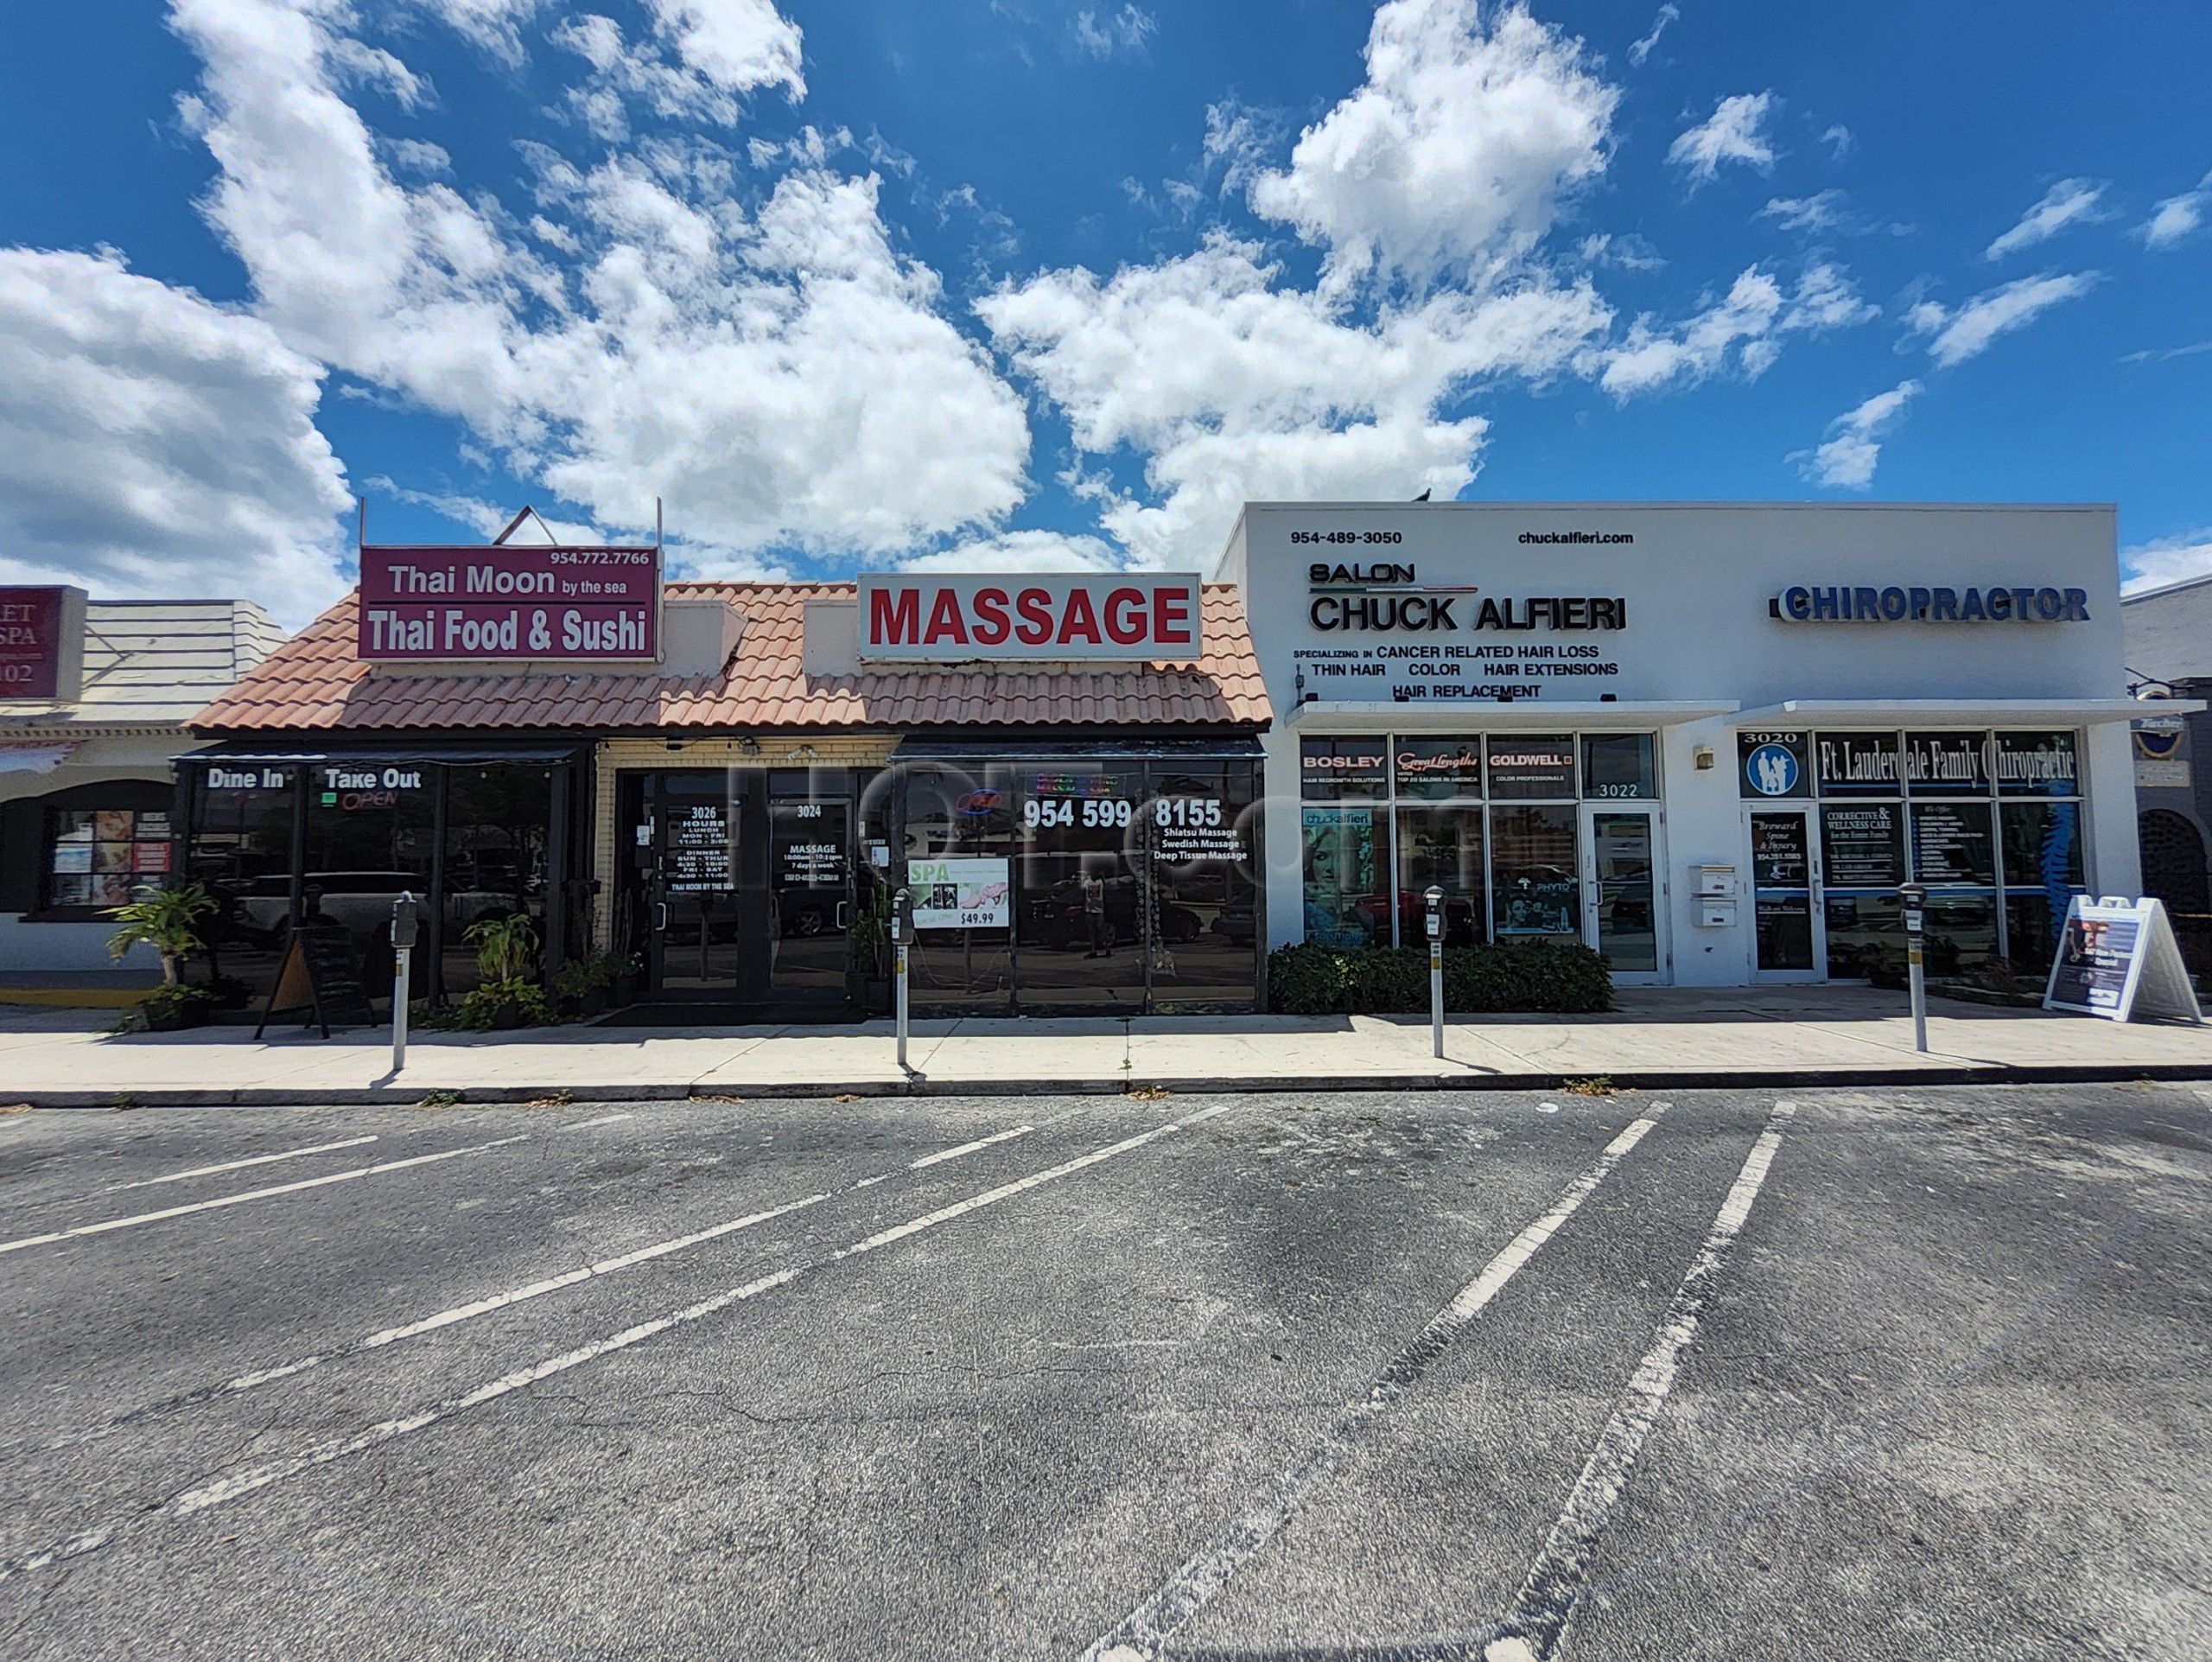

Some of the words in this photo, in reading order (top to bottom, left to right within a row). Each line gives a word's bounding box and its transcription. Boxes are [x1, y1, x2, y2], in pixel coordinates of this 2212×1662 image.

[1290, 531, 1403, 545] 954-489-3050
[1518, 532, 1634, 545] chuckalfieri.com
[550, 551, 650, 565] 954.772.7766
[1309, 564, 1415, 583] SALON
[388, 565, 456, 594] Thai
[466, 565, 556, 595] Moon
[563, 580, 577, 596] by
[580, 580, 601, 594] the
[604, 583, 627, 595] sea
[1785, 586, 2092, 622] CHIROPRACTOR
[0, 604, 37, 622] ET
[870, 587, 1192, 646] MASSAGE
[1310, 596, 1459, 632] CHUCK
[1474, 597, 1627, 631] ALFIERI
[367, 609, 435, 650] Thai
[444, 610, 518, 650] Food
[528, 609, 552, 650] &
[562, 609, 646, 650] Sushi
[1294, 650, 1359, 659] SPECIALIZING
[1363, 650, 1373, 659] IN
[1376, 646, 1440, 659] CANCER
[1445, 646, 1514, 659] RELATED
[1517, 646, 1554, 659] HAIR
[1558, 646, 1599, 658] LOSS
[1312, 664, 1346, 677] THIN
[1351, 664, 1387, 677] HAIR
[1408, 664, 1461, 677] COLOR
[1484, 664, 1520, 676] HAIR
[1524, 663, 1619, 676] EXTENSIONS
[1392, 685, 1427, 698] HAIR
[1433, 685, 1541, 697] REPLACEMENT
[1744, 733, 1797, 743] 3020
[1303, 756, 1384, 767] BOSLEY
[1490, 755, 1562, 766] GOLDWELL
[1821, 742, 1842, 780] Ft.
[1931, 741, 1980, 789] Family
[1981, 740, 2074, 788] Chiropractic
[207, 768, 257, 788] Dine
[263, 768, 283, 788] In
[324, 768, 377, 788] Take
[383, 768, 422, 788] Out
[1599, 785, 1637, 797] 3022
[342, 792, 396, 811] OPEN
[691, 806, 717, 819] 3026
[797, 806, 822, 818] 3024
[1024, 800, 1074, 828] 954
[1083, 800, 1132, 828] 599
[1156, 799, 1222, 826] 8155
[1827, 812, 1878, 820] CORRECTIVE
[1878, 806, 1891, 820] &
[1758, 820, 1797, 831] Broward
[1827, 821, 1869, 830] WELLNESS
[1869, 820, 1892, 830] CARE
[1164, 828, 1198, 837] Shiatsu
[1198, 828, 1237, 838] Massage
[1766, 832, 1789, 841] Spine
[790, 845, 836, 854] MASSAGE
[1161, 839, 1199, 848] Swedish
[1200, 839, 1240, 850] Massage
[1154, 851, 1178, 862] Deep
[1179, 851, 1207, 860] Tissue
[1208, 851, 1248, 862] Massage
[912, 864, 949, 882] SPA
[1537, 882, 1570, 891] PHYTO
[961, 913, 994, 924] $49.99
